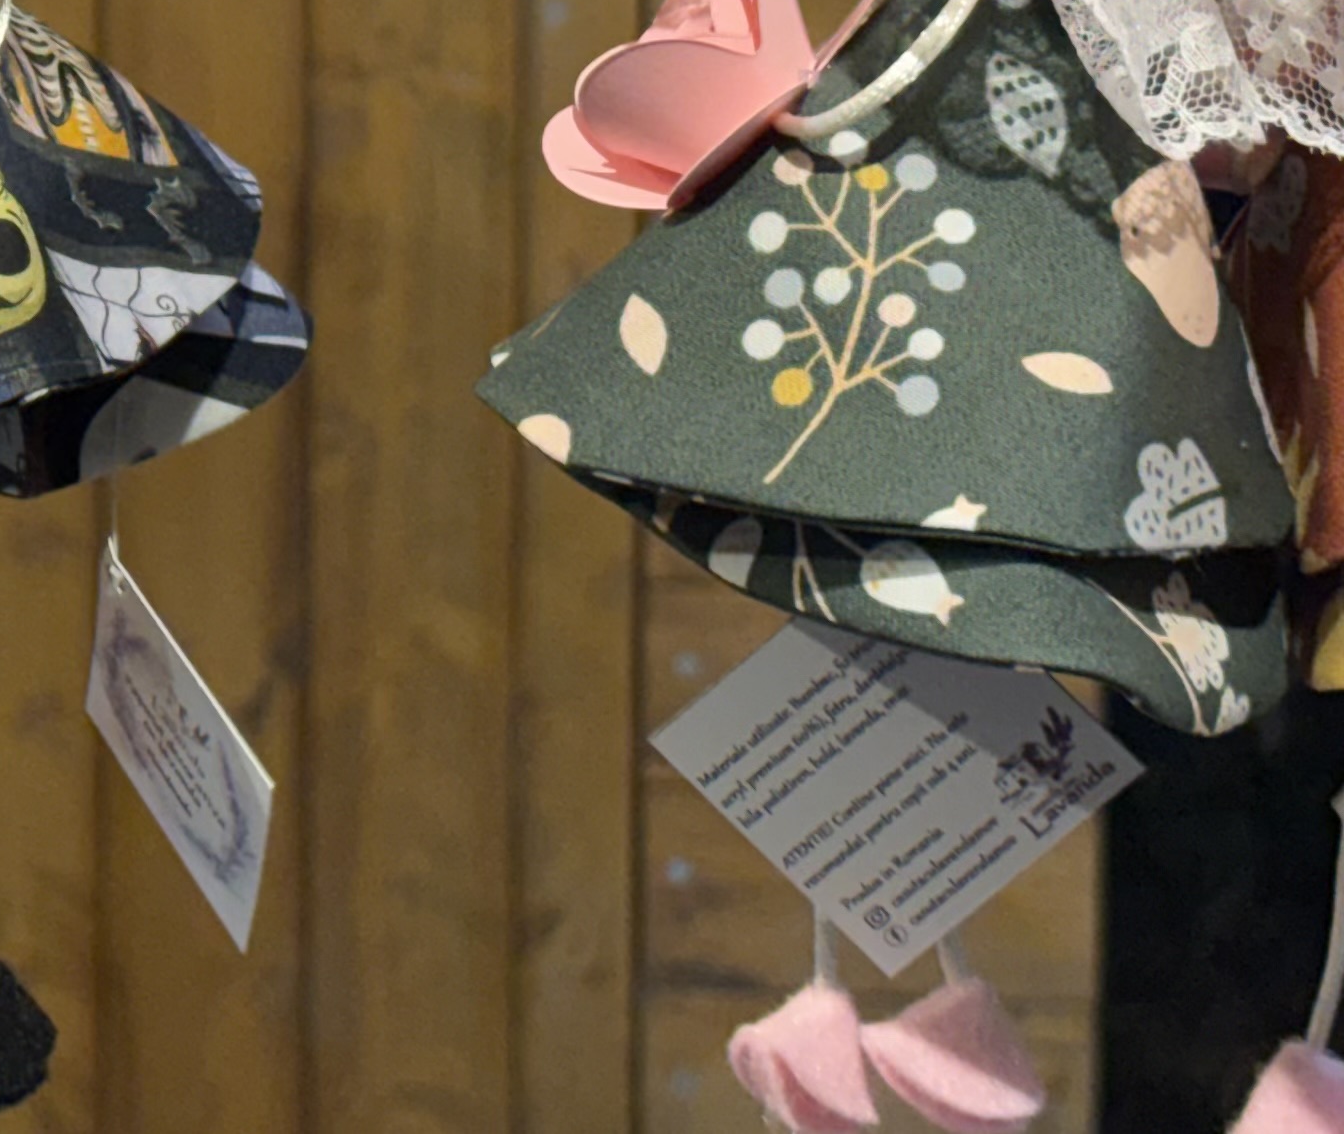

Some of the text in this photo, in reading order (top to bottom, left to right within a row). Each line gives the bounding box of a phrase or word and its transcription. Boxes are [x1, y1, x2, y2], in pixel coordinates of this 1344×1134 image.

[696, 744, 749, 788] Materiale
[745, 744, 796, 791] premium
[1018, 761, 1117, 840] Lavanda
[803, 834, 867, 889] recomandat
[864, 807, 902, 844] pentru
[926, 766, 948, 789] sub
[841, 875, 883, 910] Produs
[894, 828, 945, 867] Romania
